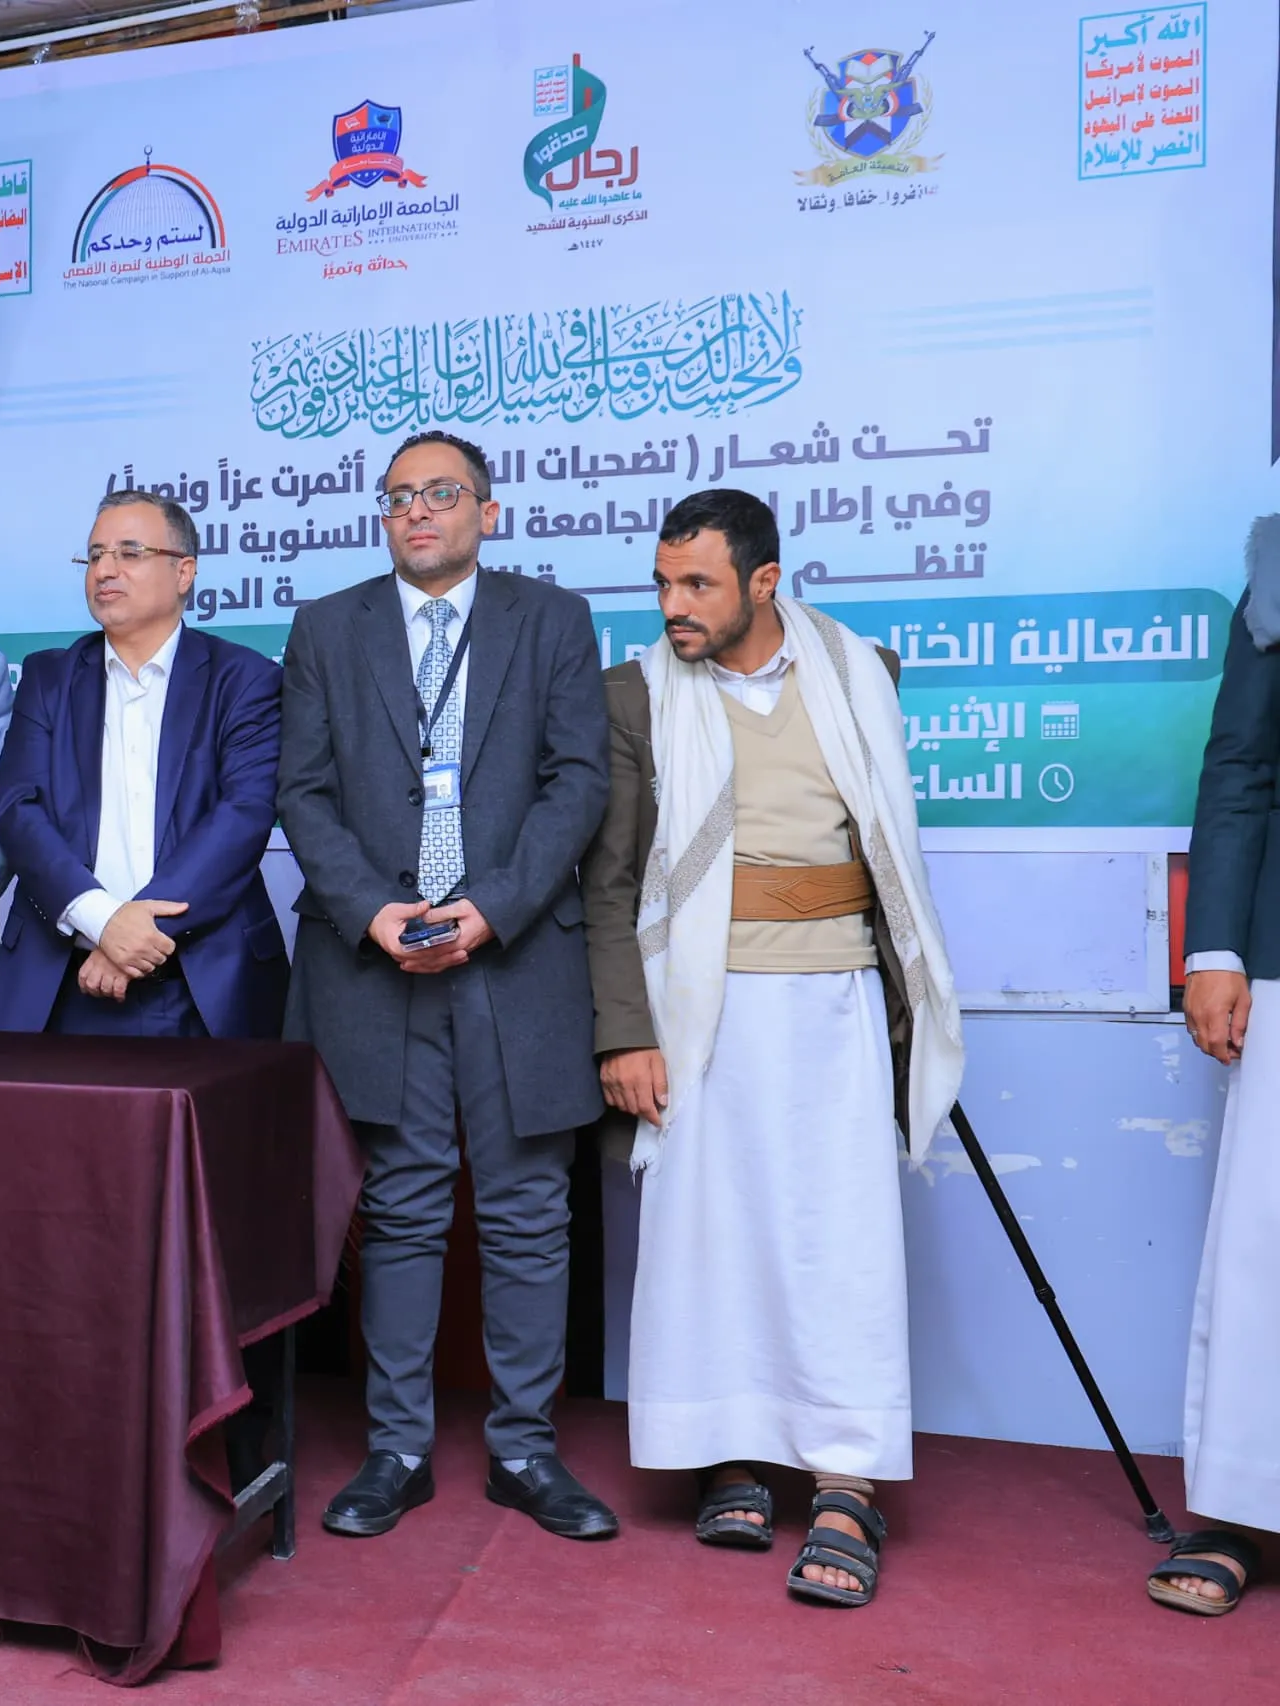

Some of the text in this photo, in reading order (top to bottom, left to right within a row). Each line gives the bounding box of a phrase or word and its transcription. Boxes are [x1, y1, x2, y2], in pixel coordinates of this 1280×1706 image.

[545, 145, 639, 192] رجال
[275, 193, 460, 234] الجامعة الإماراتية الدولية
[276, 219, 458, 257] EMIRATES INTERNATIONAL
[87, 223, 205, 259] لستم وحدكم
[709, 420, 839, 482] شعار
[852, 416, 993, 460] تحت
[271, 449, 365, 508] أثمرت
[789, 485, 874, 537] إطار
[885, 481, 991, 531] وفي
[239, 514, 381, 563] السنوية
[792, 542, 988, 598] تنظم
[1010, 614, 1209, 674] الفعالية
[911, 763, 1023, 800] الساع
